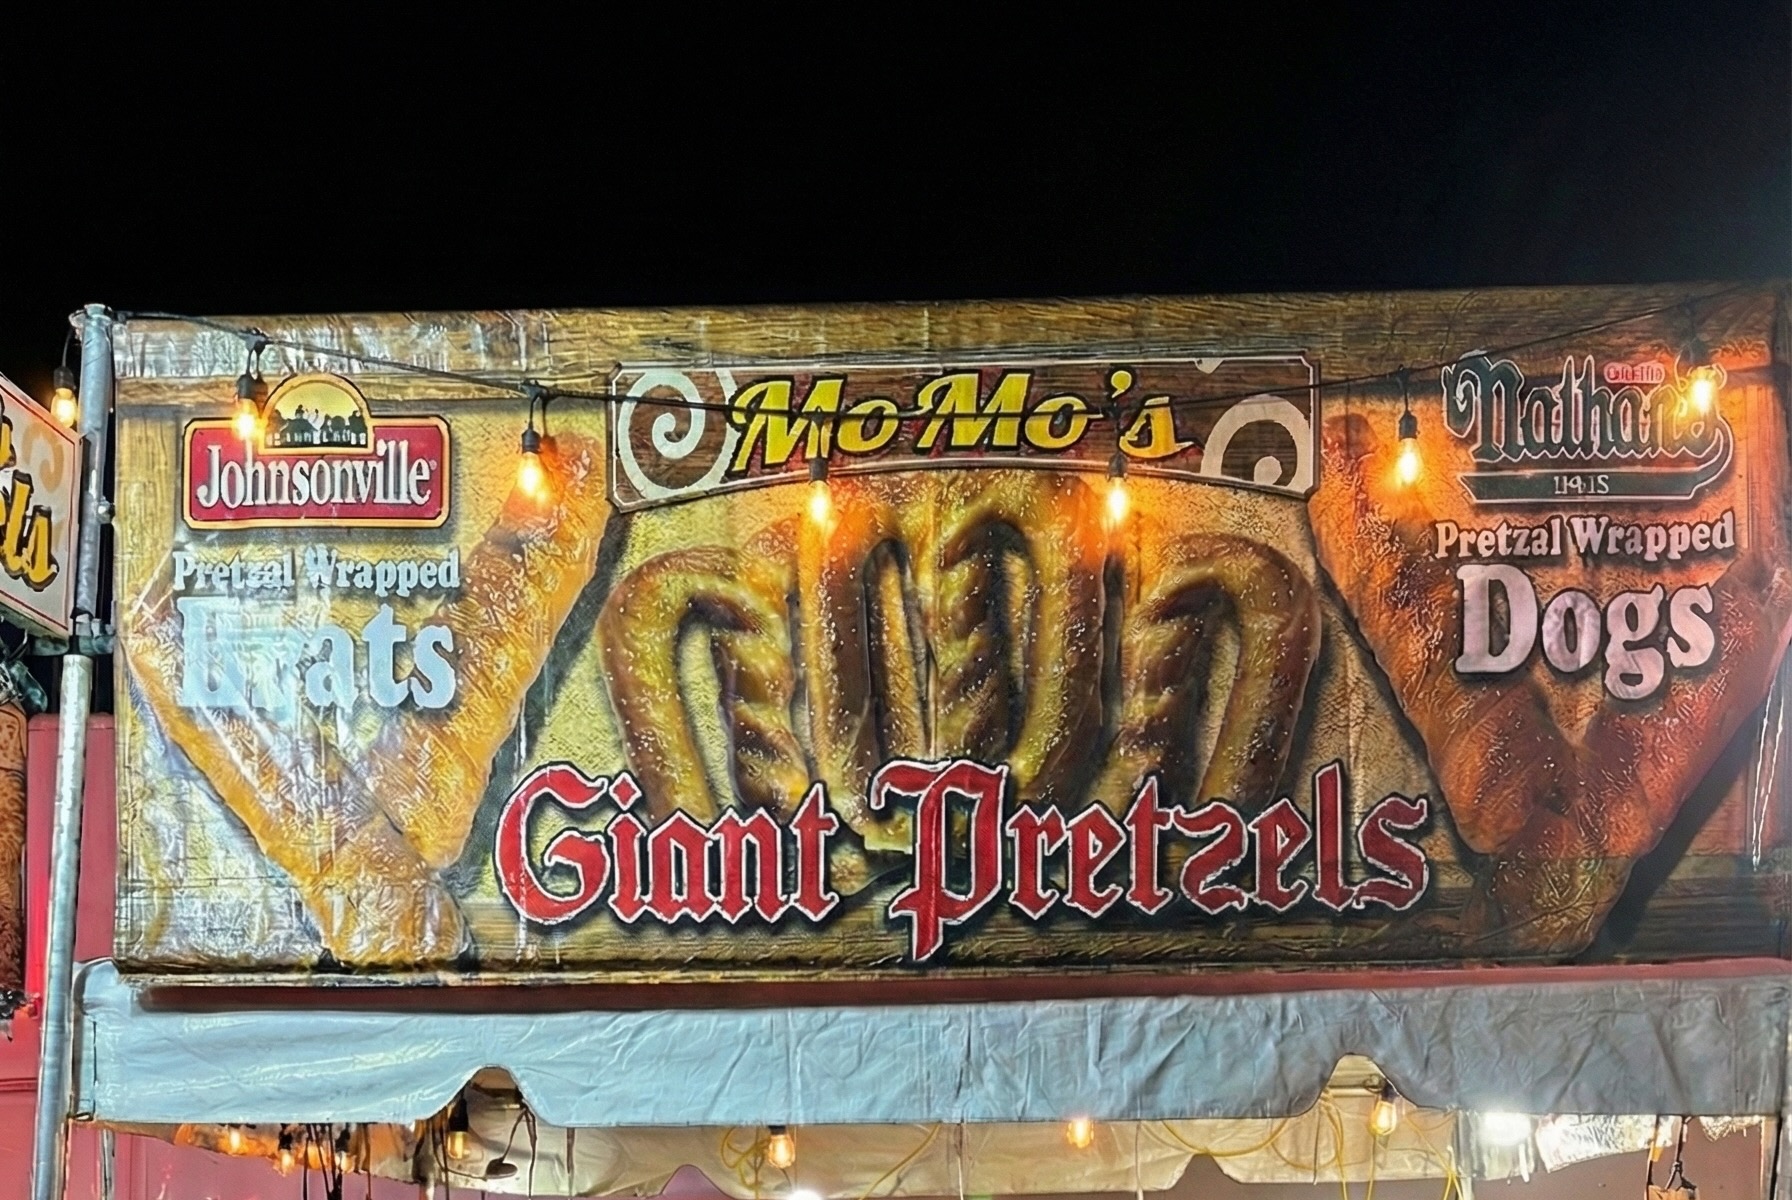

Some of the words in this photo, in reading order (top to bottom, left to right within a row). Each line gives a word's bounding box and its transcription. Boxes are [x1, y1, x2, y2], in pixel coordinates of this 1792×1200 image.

[724, 368, 1195, 476] MoMo's
[196, 438, 432, 510] Johnsonville
[305, 545, 461, 598] Wrapped
[1571, 510, 1736, 562] Wrapped
[1454, 562, 1718, 702] Dogs
[493, 760, 841, 927] Giant
[868, 756, 1432, 964] Pretzels
